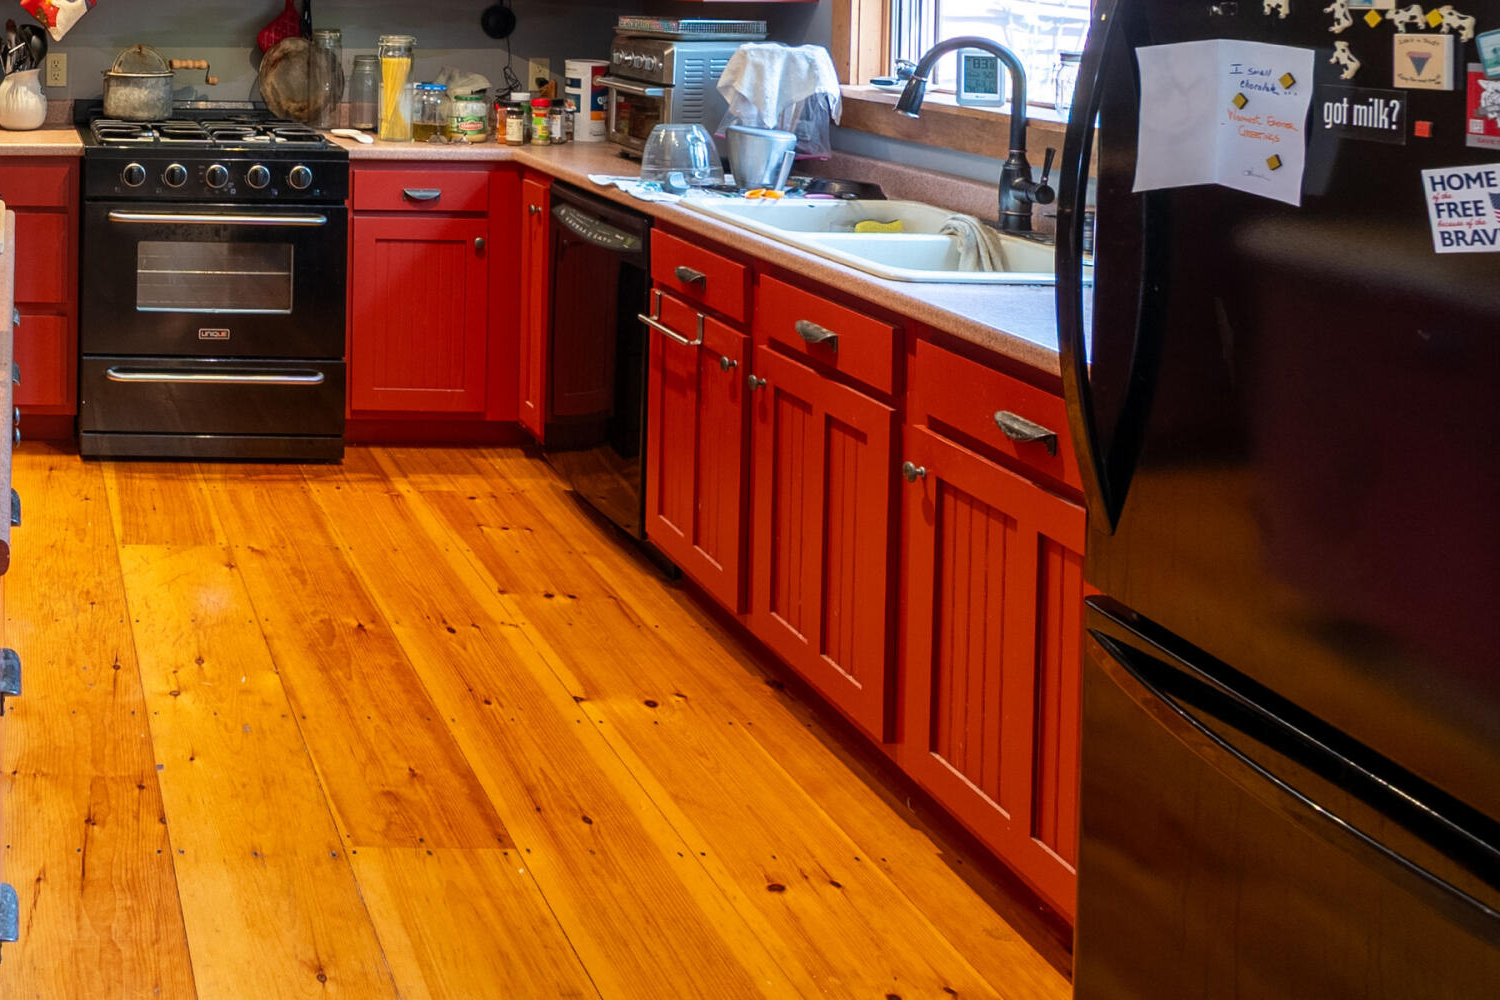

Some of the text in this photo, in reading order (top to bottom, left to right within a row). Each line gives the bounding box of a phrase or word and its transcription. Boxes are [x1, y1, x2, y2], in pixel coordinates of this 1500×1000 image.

[973, 58, 988, 69] 83
[1229, 63, 1243, 75] I
[1323, 97, 1400, 130] got milk?
[1429, 171, 1498, 192] HOME
[1432, 192, 1440, 203] of
[1434, 200, 1487, 219] FREE
[1439, 228, 1500, 247] BRAV
